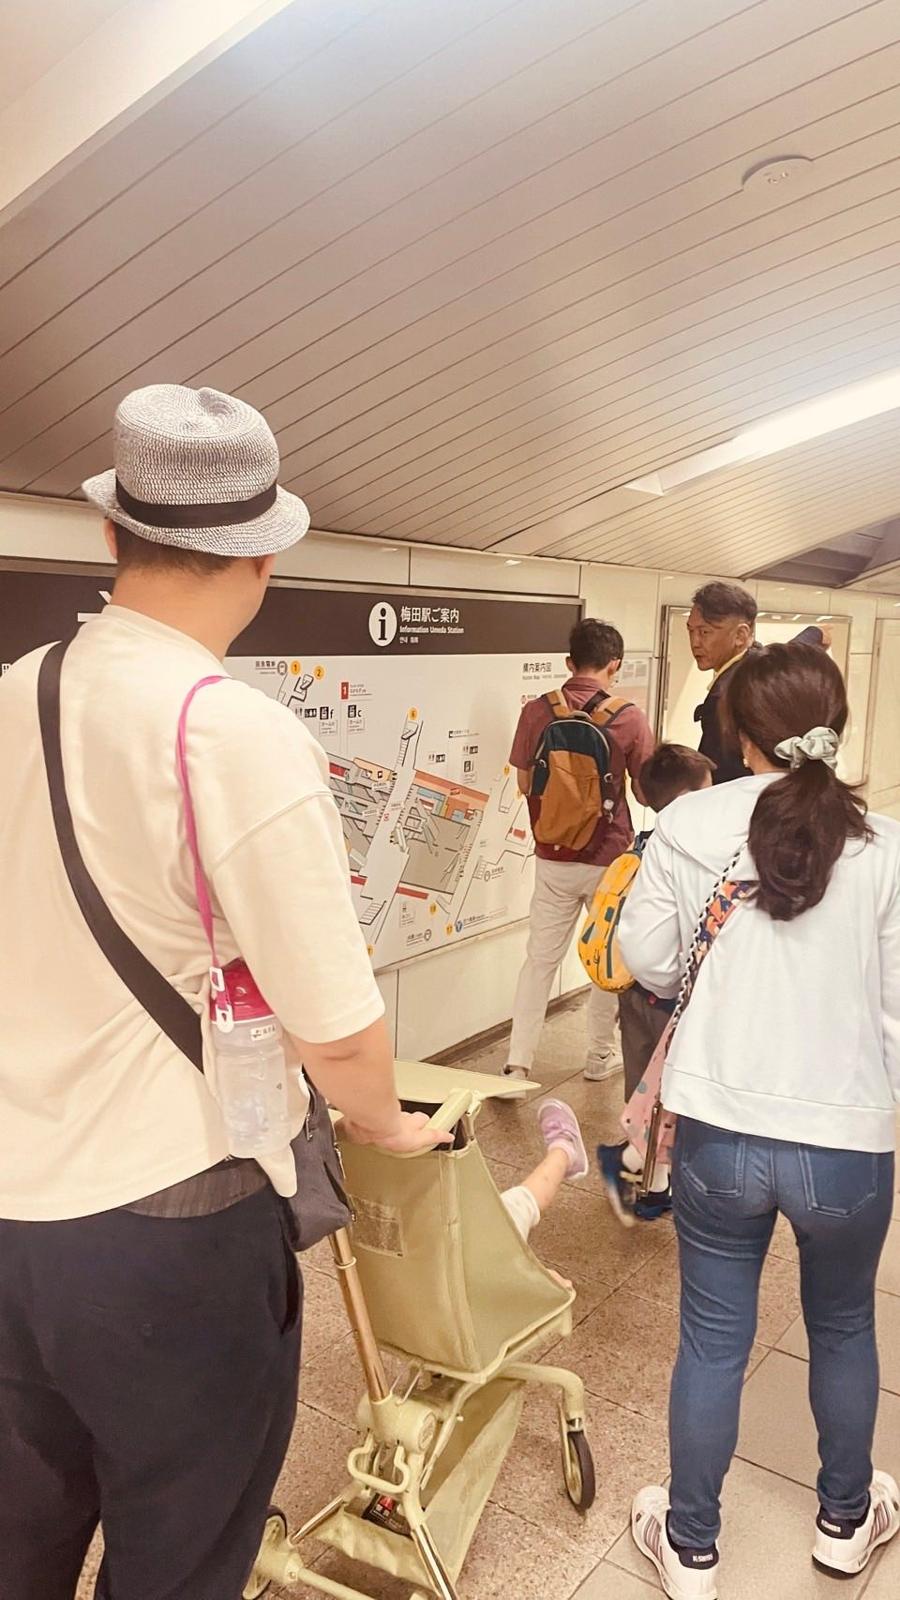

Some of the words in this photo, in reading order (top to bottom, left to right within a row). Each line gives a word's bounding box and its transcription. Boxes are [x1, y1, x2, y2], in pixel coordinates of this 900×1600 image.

[400, 606, 460, 624] 梅田駅ご案内
[399, 624, 429, 634] Information
[430, 626, 447, 634] Umeda
[447, 626, 465, 634] Station
